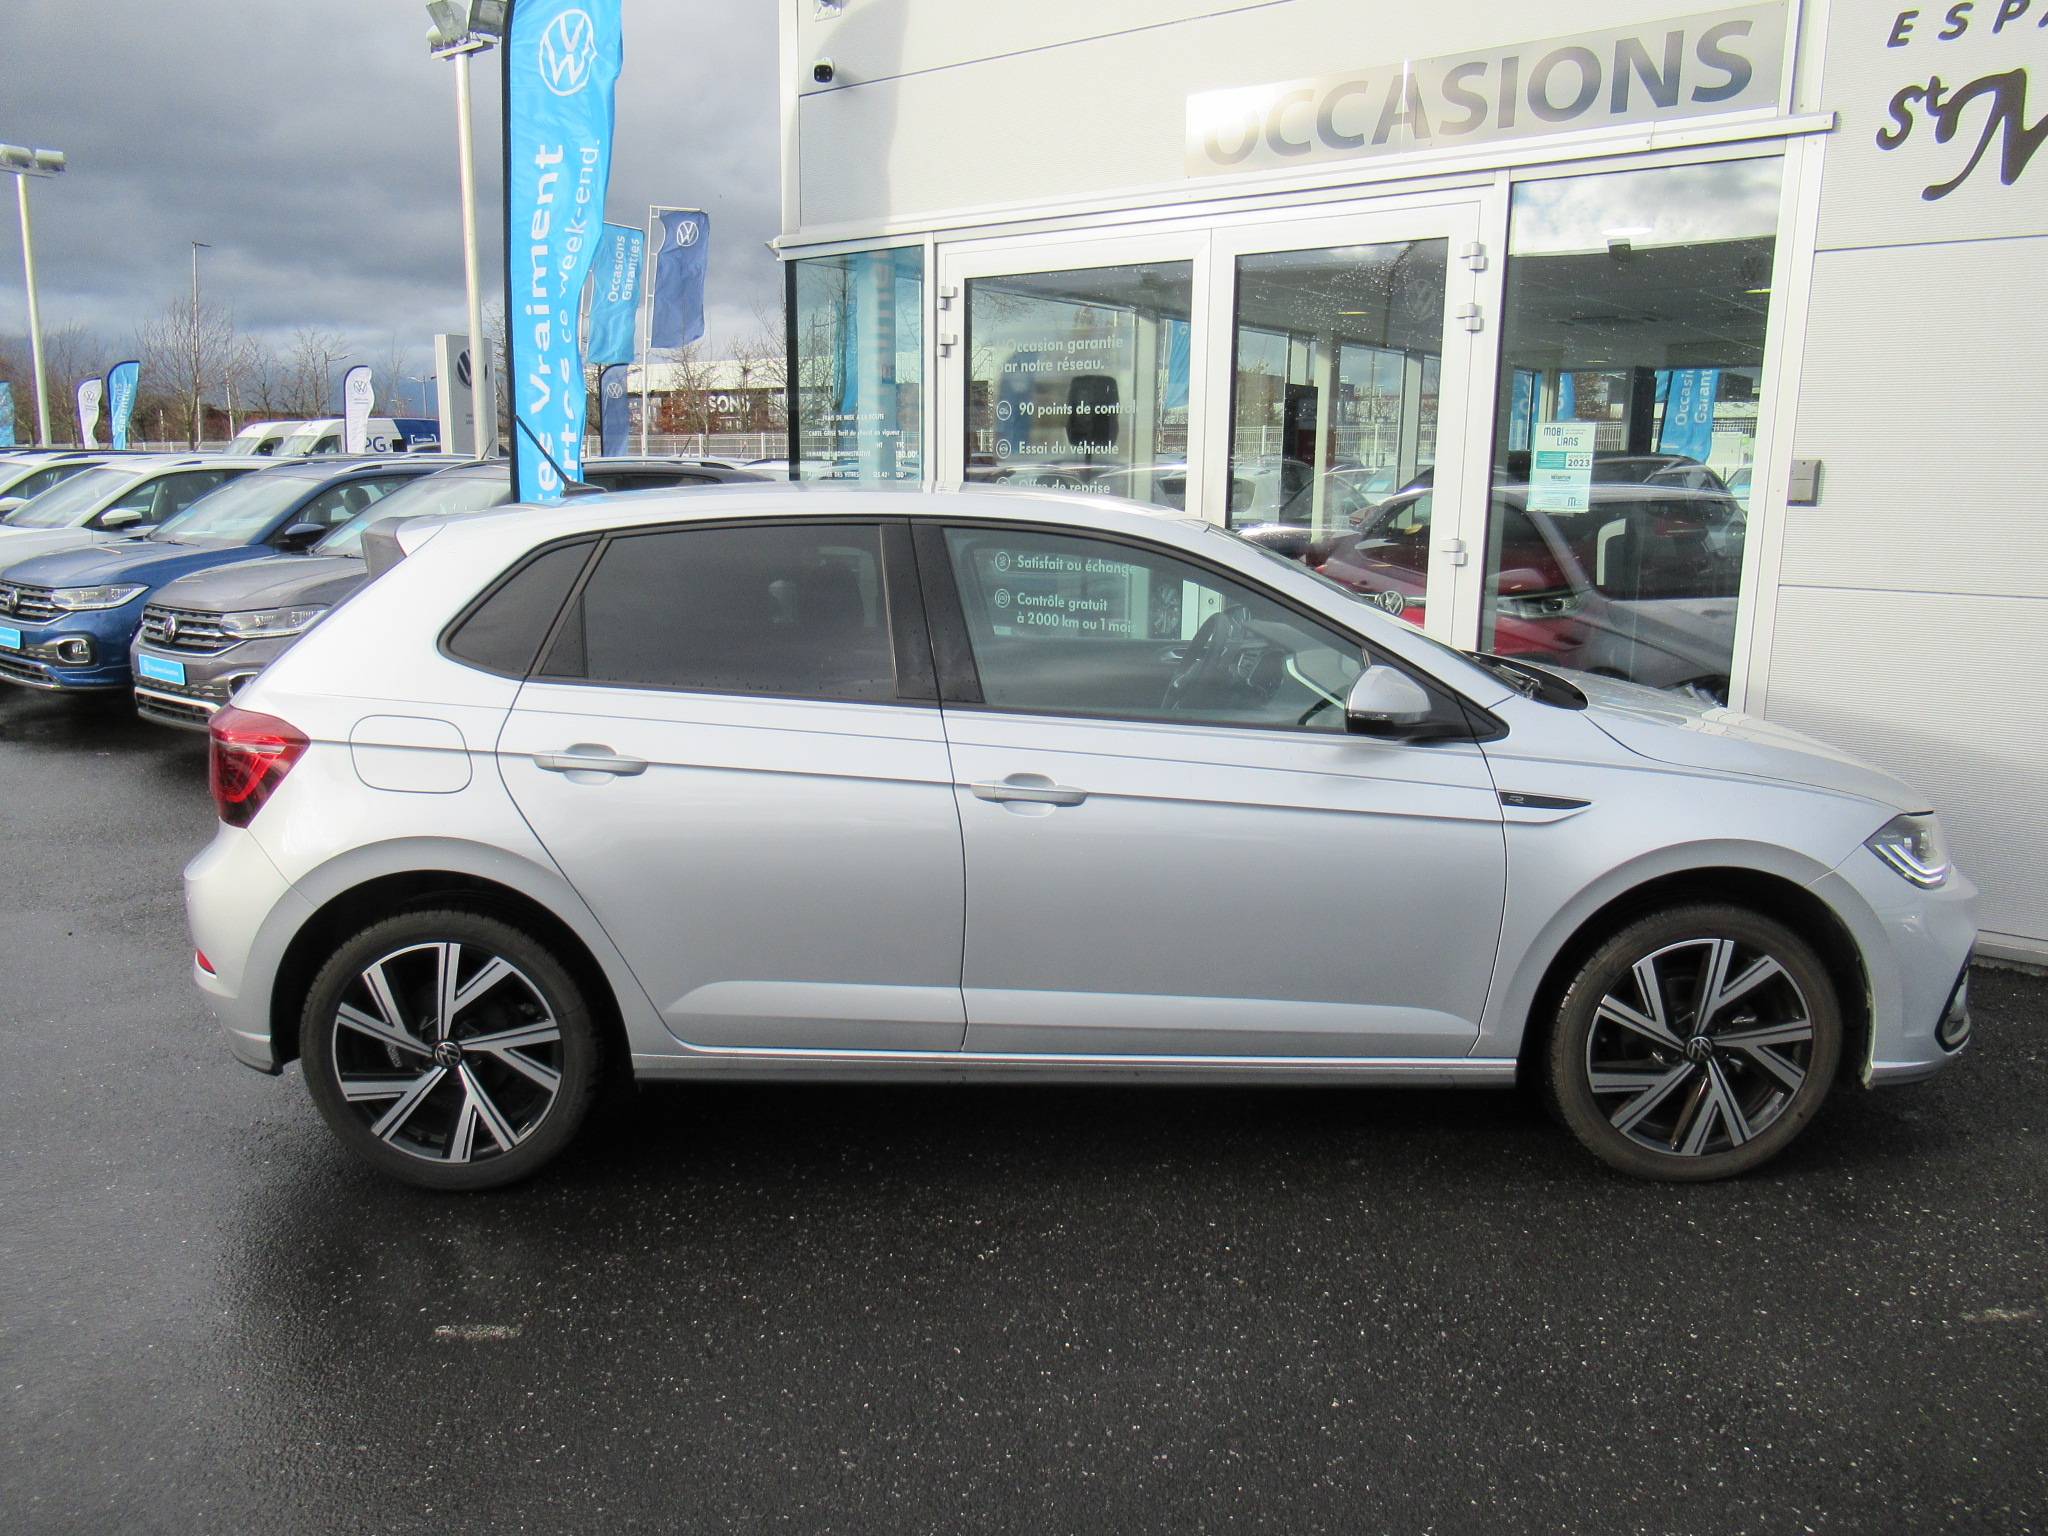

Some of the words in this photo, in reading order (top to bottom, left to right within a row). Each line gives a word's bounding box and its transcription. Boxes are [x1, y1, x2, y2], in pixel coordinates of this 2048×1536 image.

[1203, 20, 1754, 167] OCCASIONS
[607, 235, 626, 303] Occasions
[622, 238, 641, 301] Garanties
[525, 144, 565, 415] Vraiment
[1067, 334, 1124, 354] garantie
[1021, 359, 1053, 372] notre
[1019, 402, 1035, 416] 90
[1037, 402, 1073, 419] points
[1076, 401, 1091, 415] de
[1019, 441, 1048, 455] Essai
[1051, 441, 1066, 454] du
[1070, 440, 1119, 455] véhicule
[1567, 459, 1591, 468] 2023
[1018, 555, 1063, 570] Satisfait
[1067, 563, 1081, 572] ou
[1017, 592, 1065, 608] Contrôle
[1068, 599, 1107, 612] gratuit
[1017, 612, 1024, 624] à
[1062, 614, 1079, 629] km
[1083, 621, 1097, 631] ou
